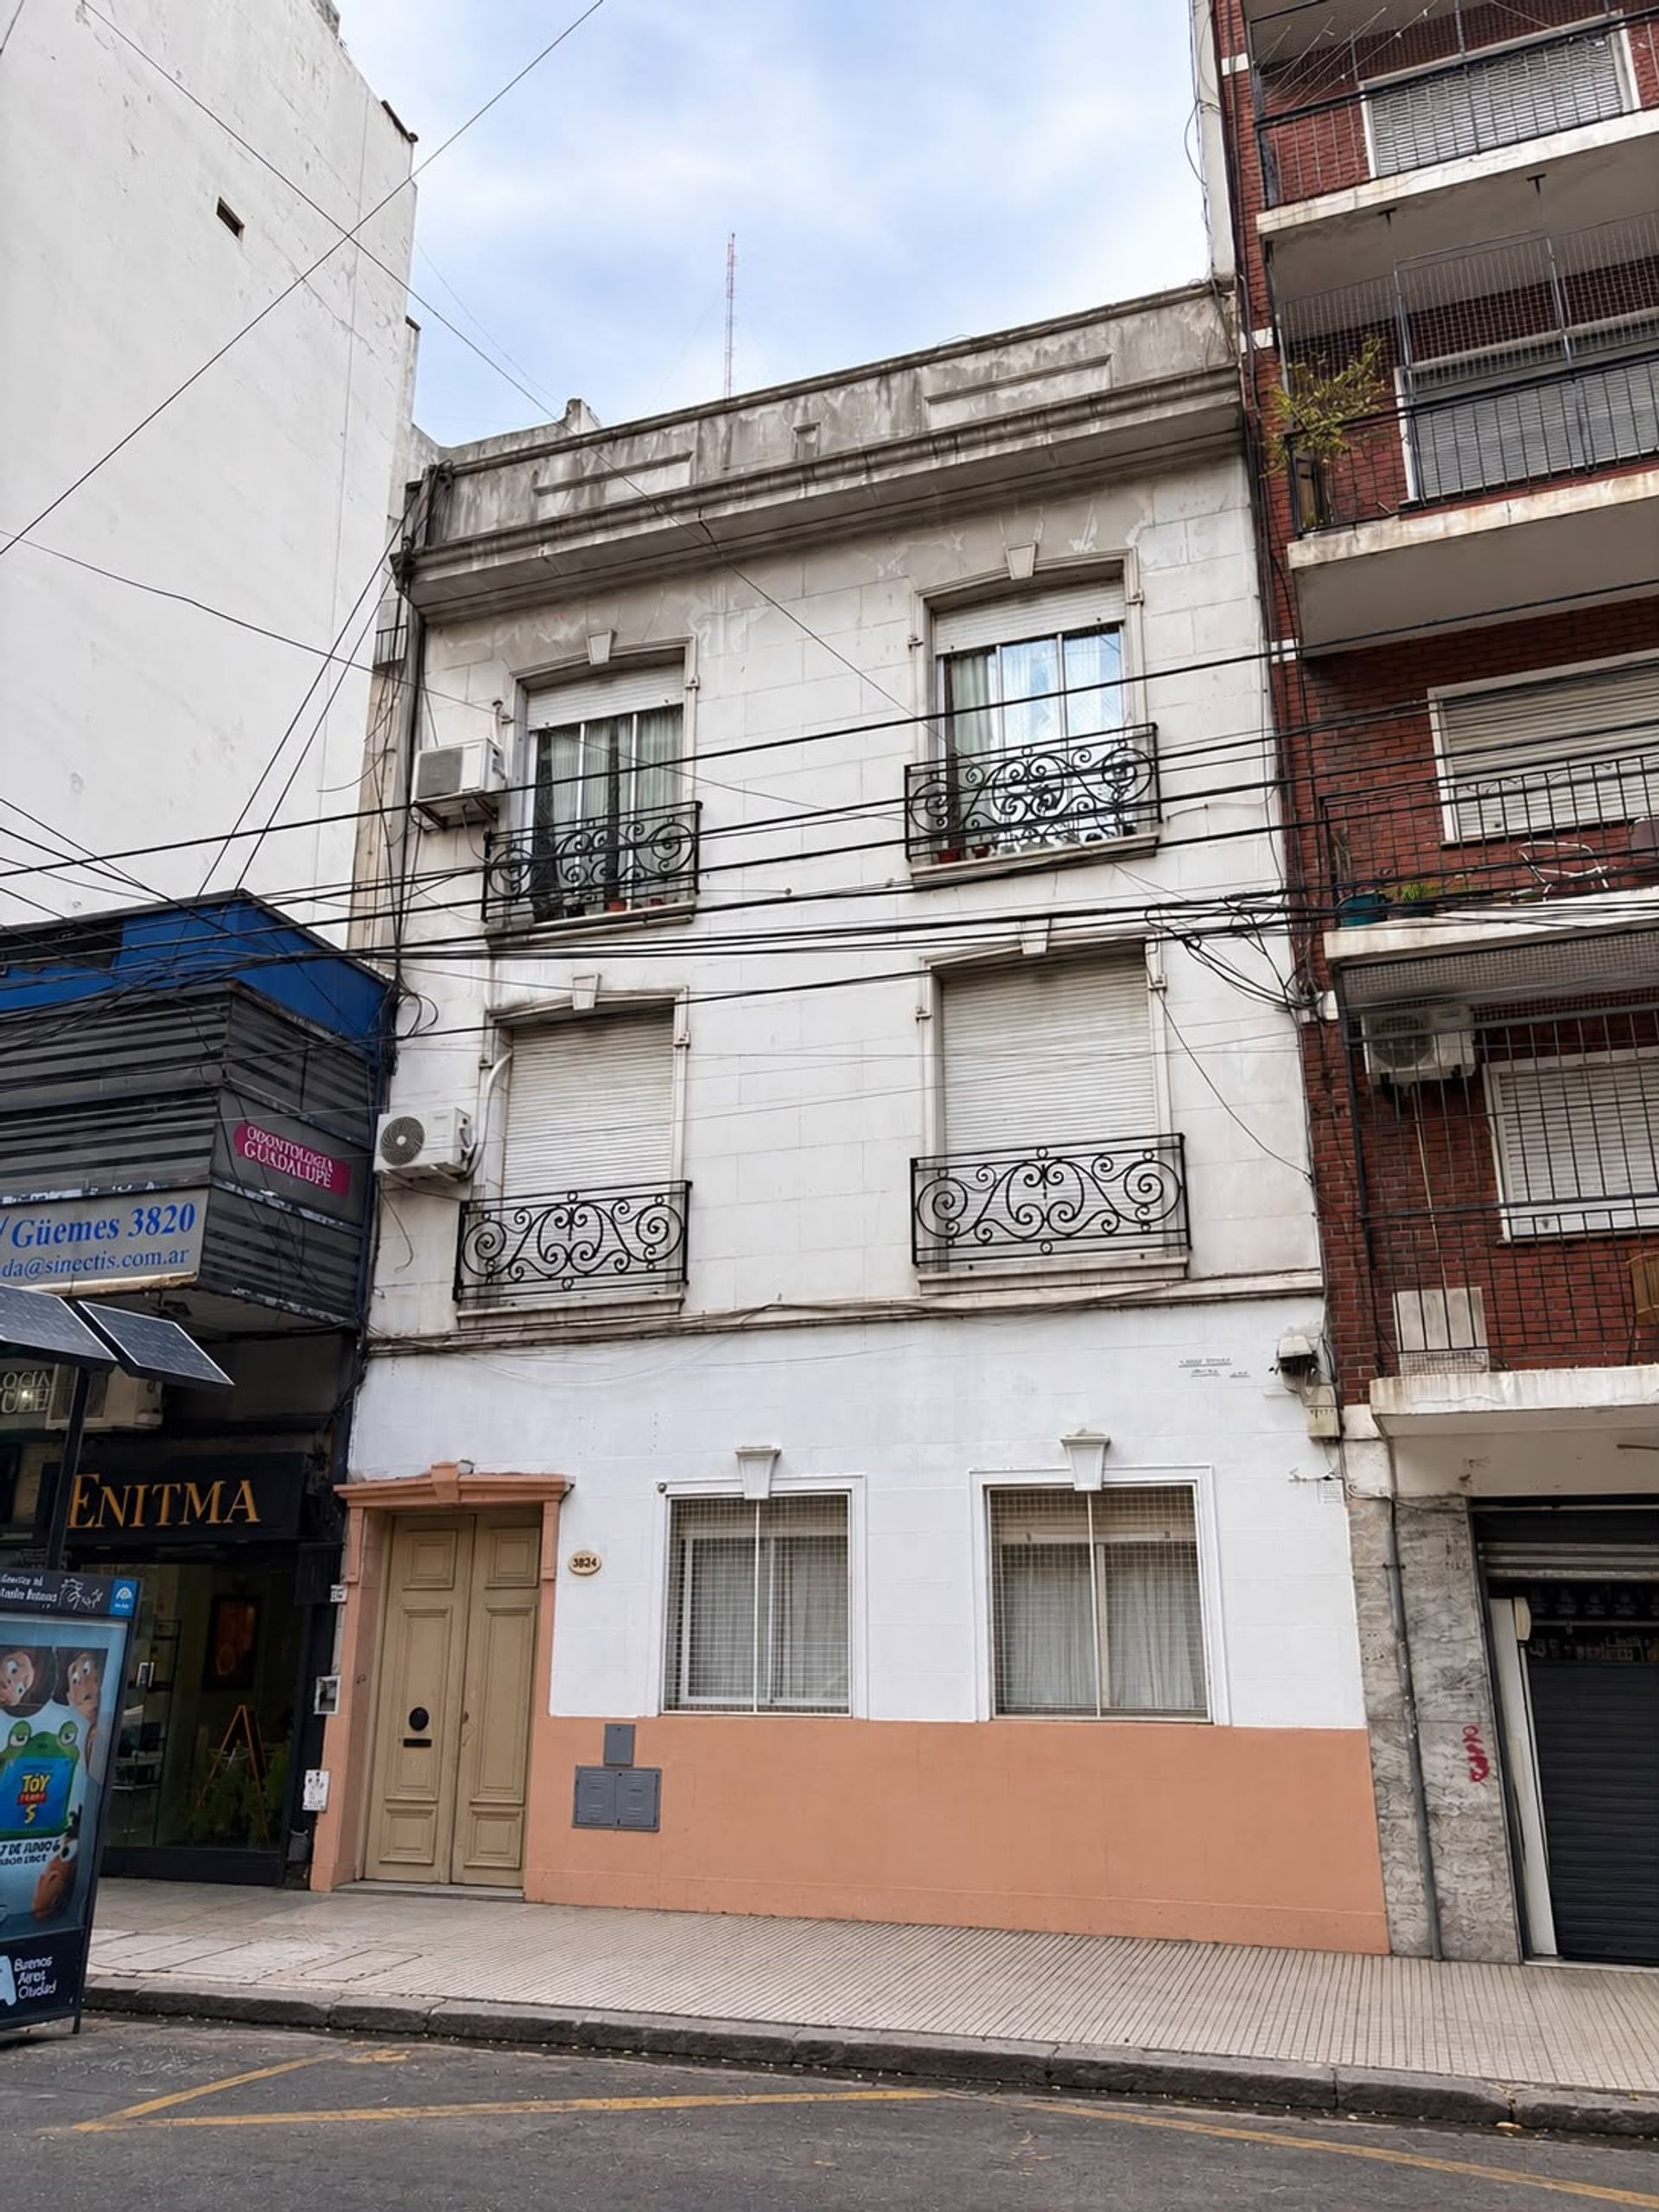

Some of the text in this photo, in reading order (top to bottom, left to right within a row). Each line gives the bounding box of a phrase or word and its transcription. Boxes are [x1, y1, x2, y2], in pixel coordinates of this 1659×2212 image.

[244, 1141, 332, 1188] GUADALUPE
[11, 1217, 120, 1249] Güemes
[127, 1202, 196, 1237] 3820
[67, 1472, 261, 1529] ENITMA
[572, 1557, 598, 1569] 3824
[22, 1774, 51, 1793] TOY
